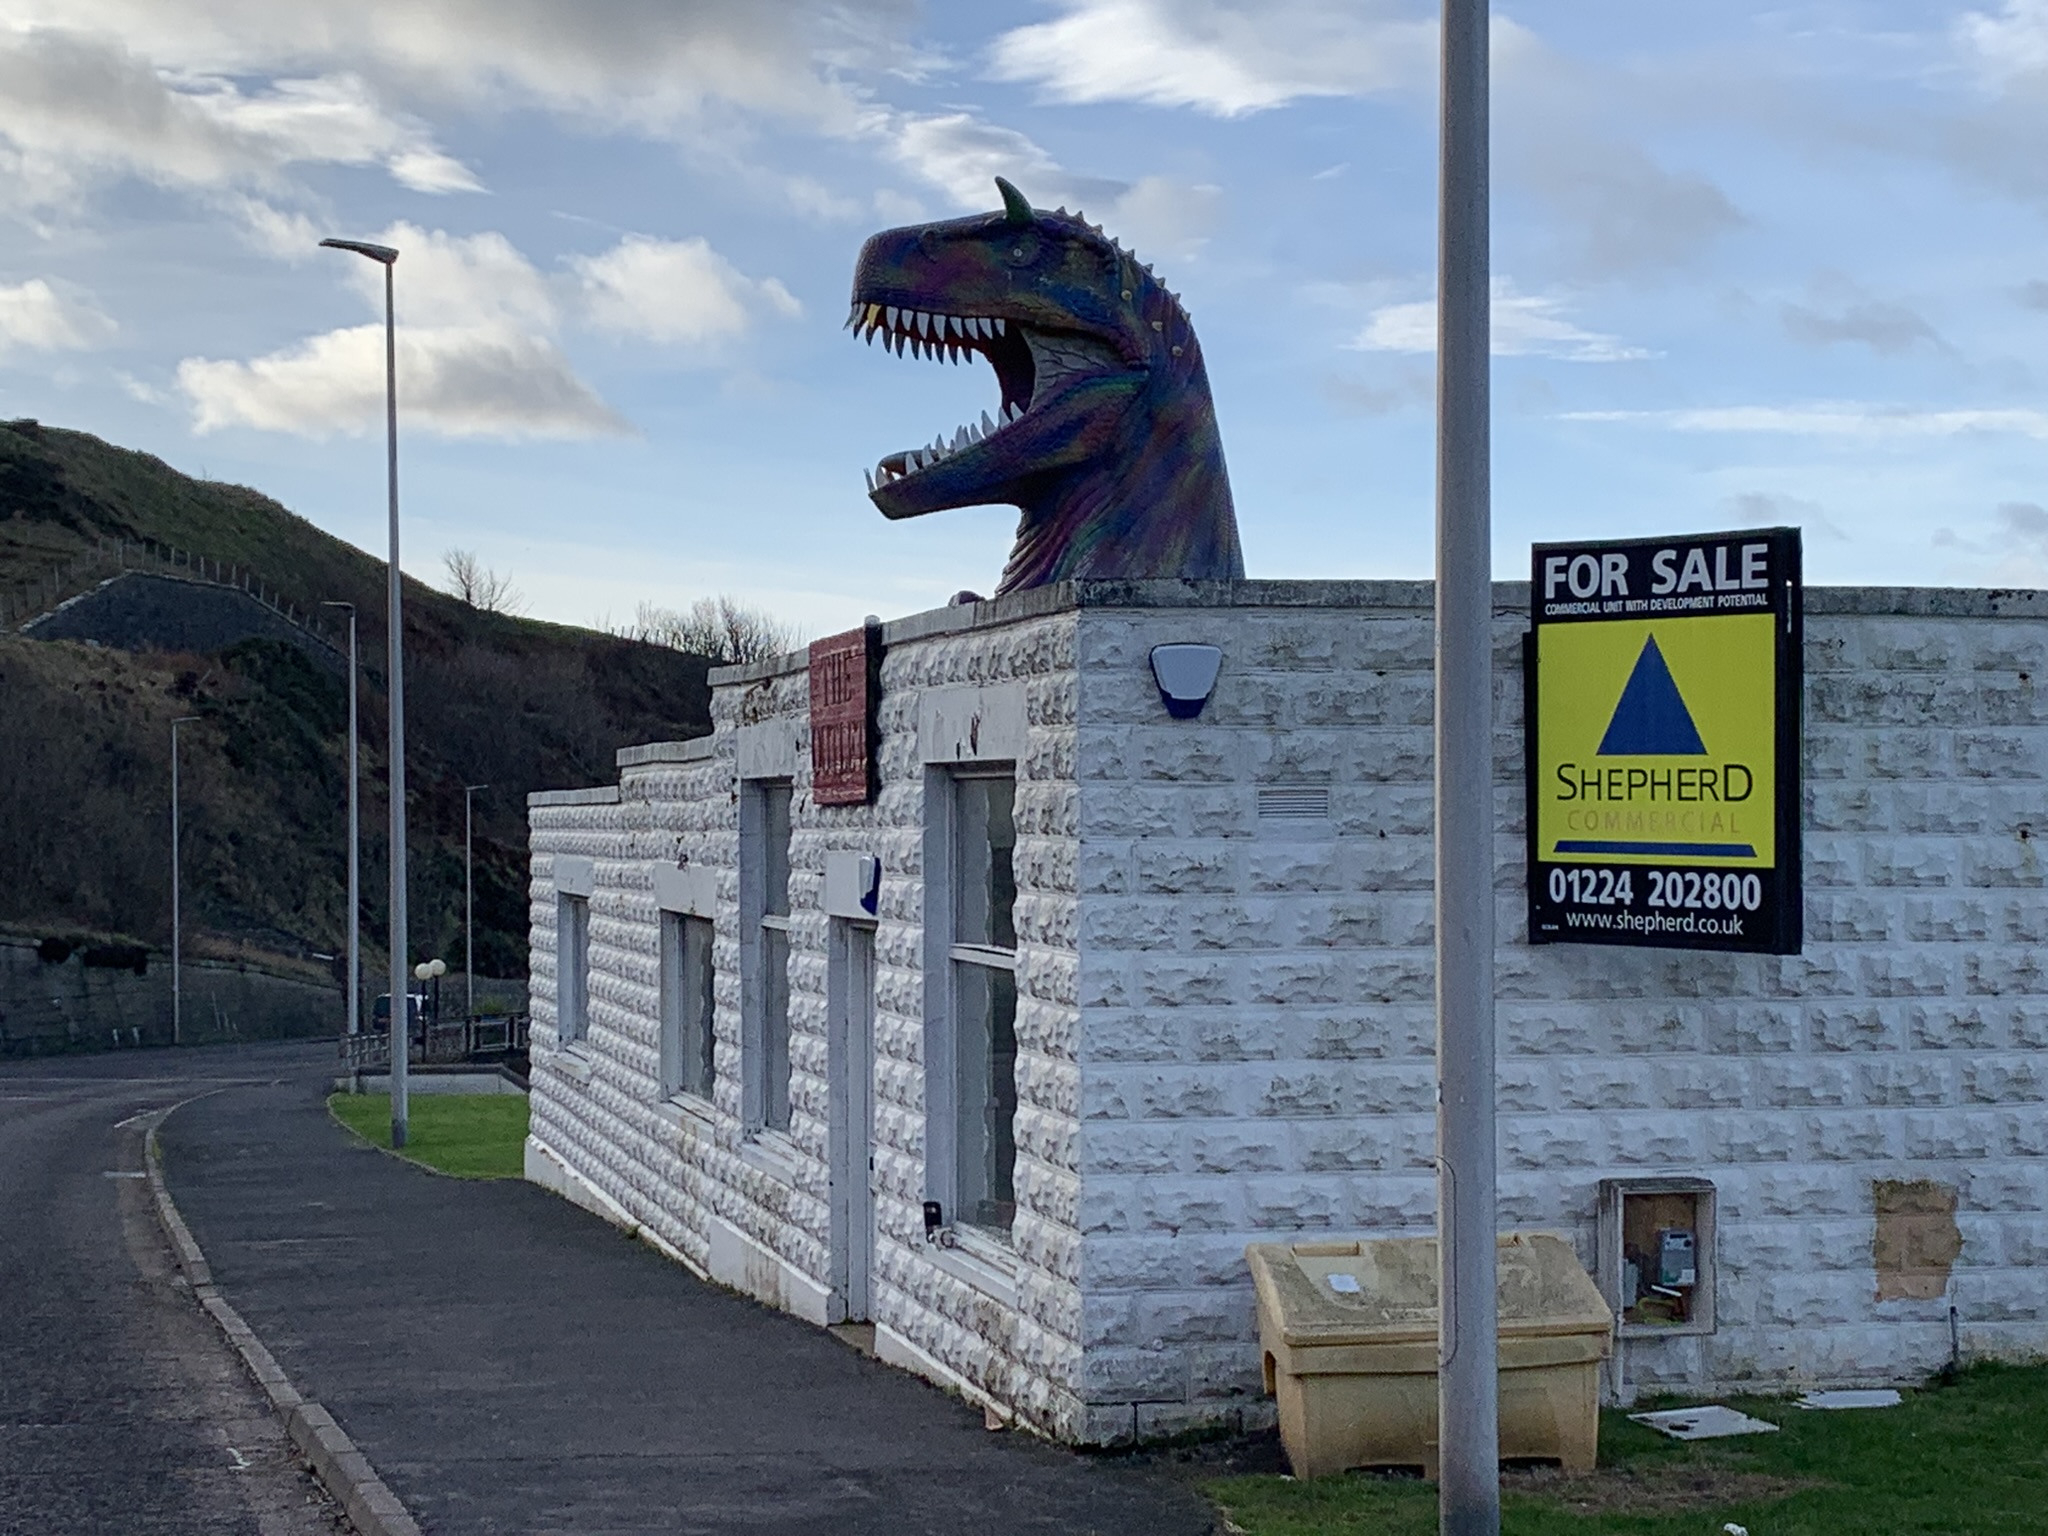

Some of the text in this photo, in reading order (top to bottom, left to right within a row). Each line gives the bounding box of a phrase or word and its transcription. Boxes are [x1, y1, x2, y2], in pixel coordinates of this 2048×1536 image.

[1545, 543, 1769, 599] FOR SALE
[1545, 593, 1768, 615] COMMERCIAL UNIT WITH DEVELOPMENT POTENTIAL
[820, 649, 855, 707] THE
[1567, 810, 1741, 833] COMMERCIAL
[1549, 867, 1762, 911] 01224 202800
[1566, 909, 1743, 935] www.shepherd.co.uk
